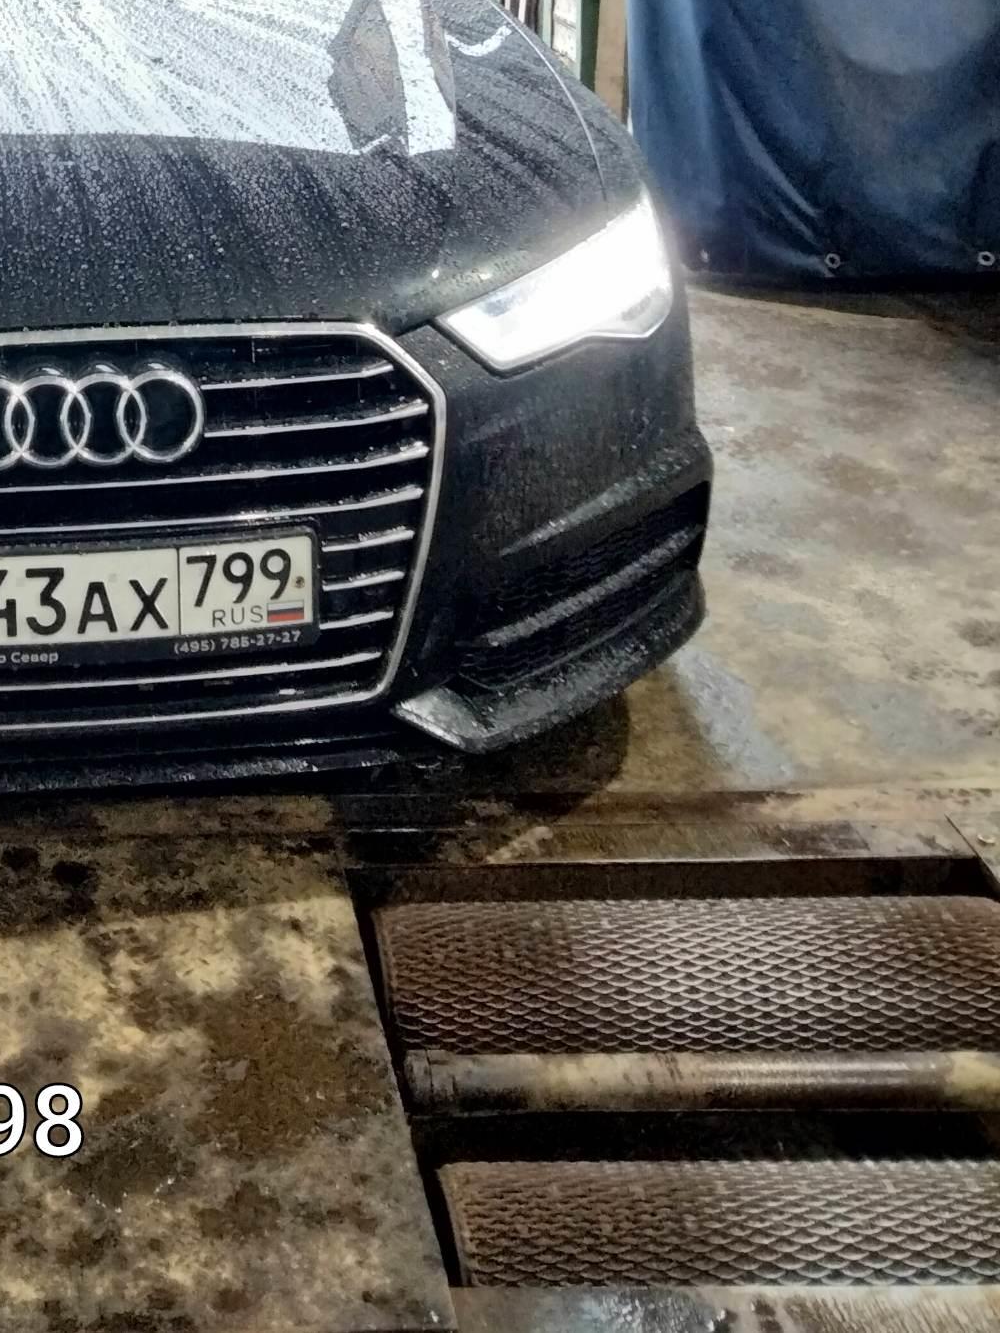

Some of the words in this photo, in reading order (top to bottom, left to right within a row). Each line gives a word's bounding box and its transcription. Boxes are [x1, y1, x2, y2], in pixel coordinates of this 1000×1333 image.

[186, 548, 292, 607] 799
[212, 605, 264, 628] RUS
[173, 638, 216, 655] (495)
[220, 630, 302, 650] 785-27-27
[10, 651, 59, 664] Север
